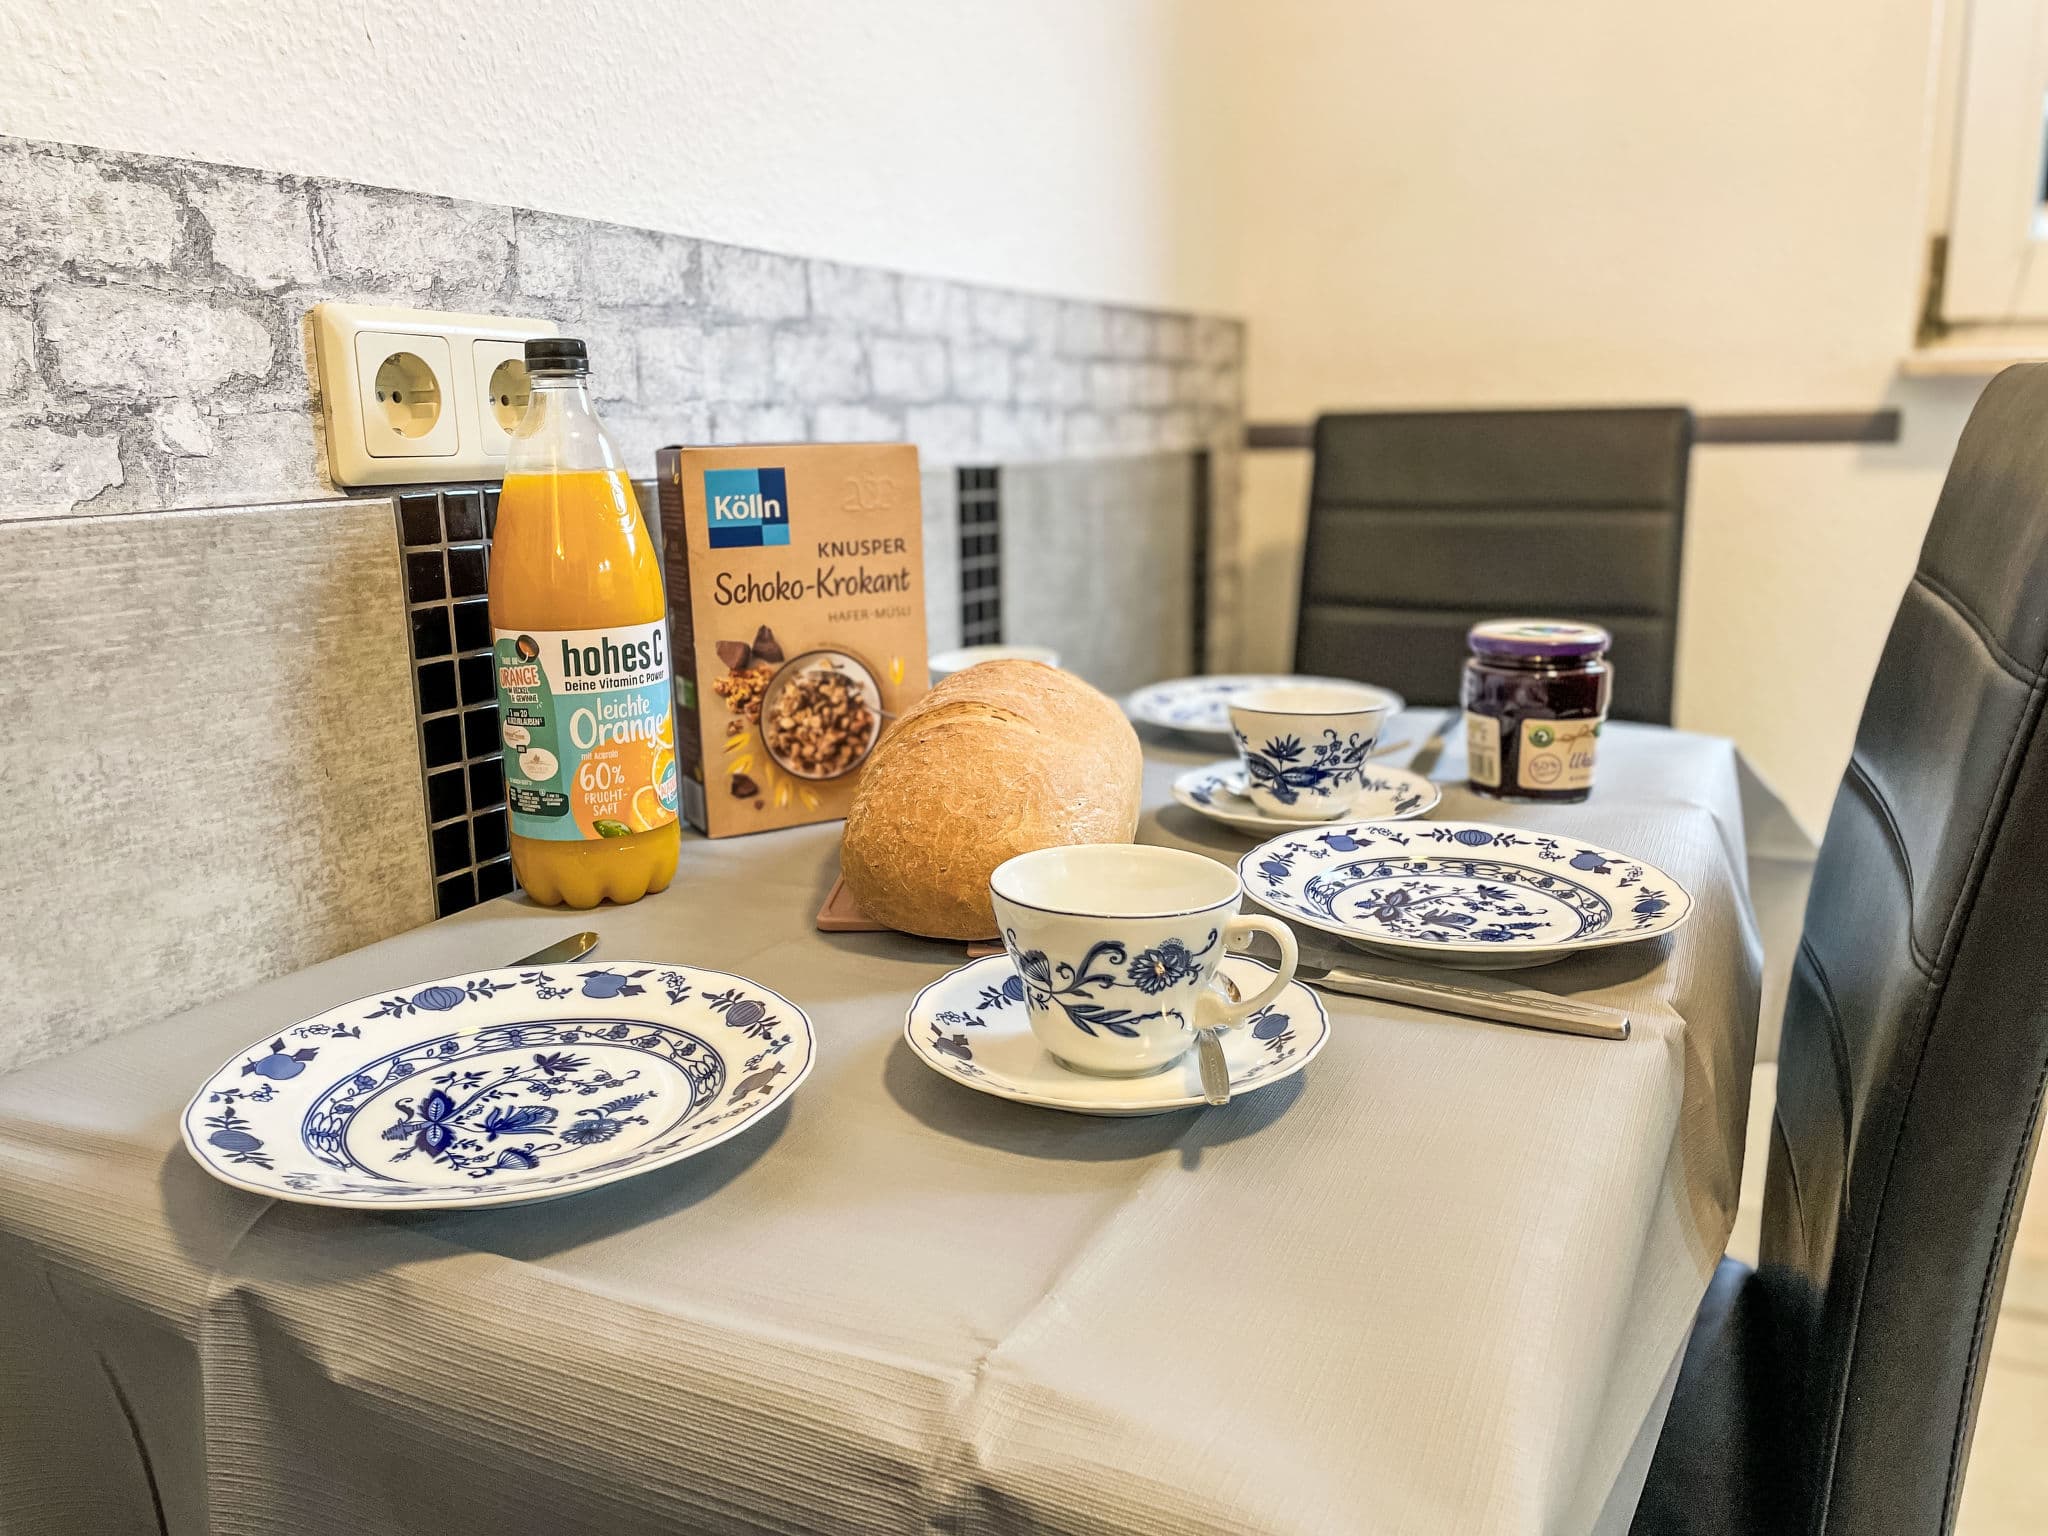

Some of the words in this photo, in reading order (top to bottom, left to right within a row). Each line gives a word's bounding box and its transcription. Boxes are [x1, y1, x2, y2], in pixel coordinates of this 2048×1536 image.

[714, 493, 781, 521] Kölln
[818, 538, 907, 559] KNUSPER
[714, 564, 911, 606] Schoko-Krokant
[828, 606, 911, 624] HAFER-MÜSLI
[565, 680, 596, 692] Deine
[599, 676, 638, 690] Vitamin
[639, 674, 645, 686] C
[646, 671, 665, 685] Power
[597, 696, 650, 720] leichte
[569, 707, 664, 750] Orange
[580, 762, 625, 791] 60%
[593, 802, 618, 817] SAFT
